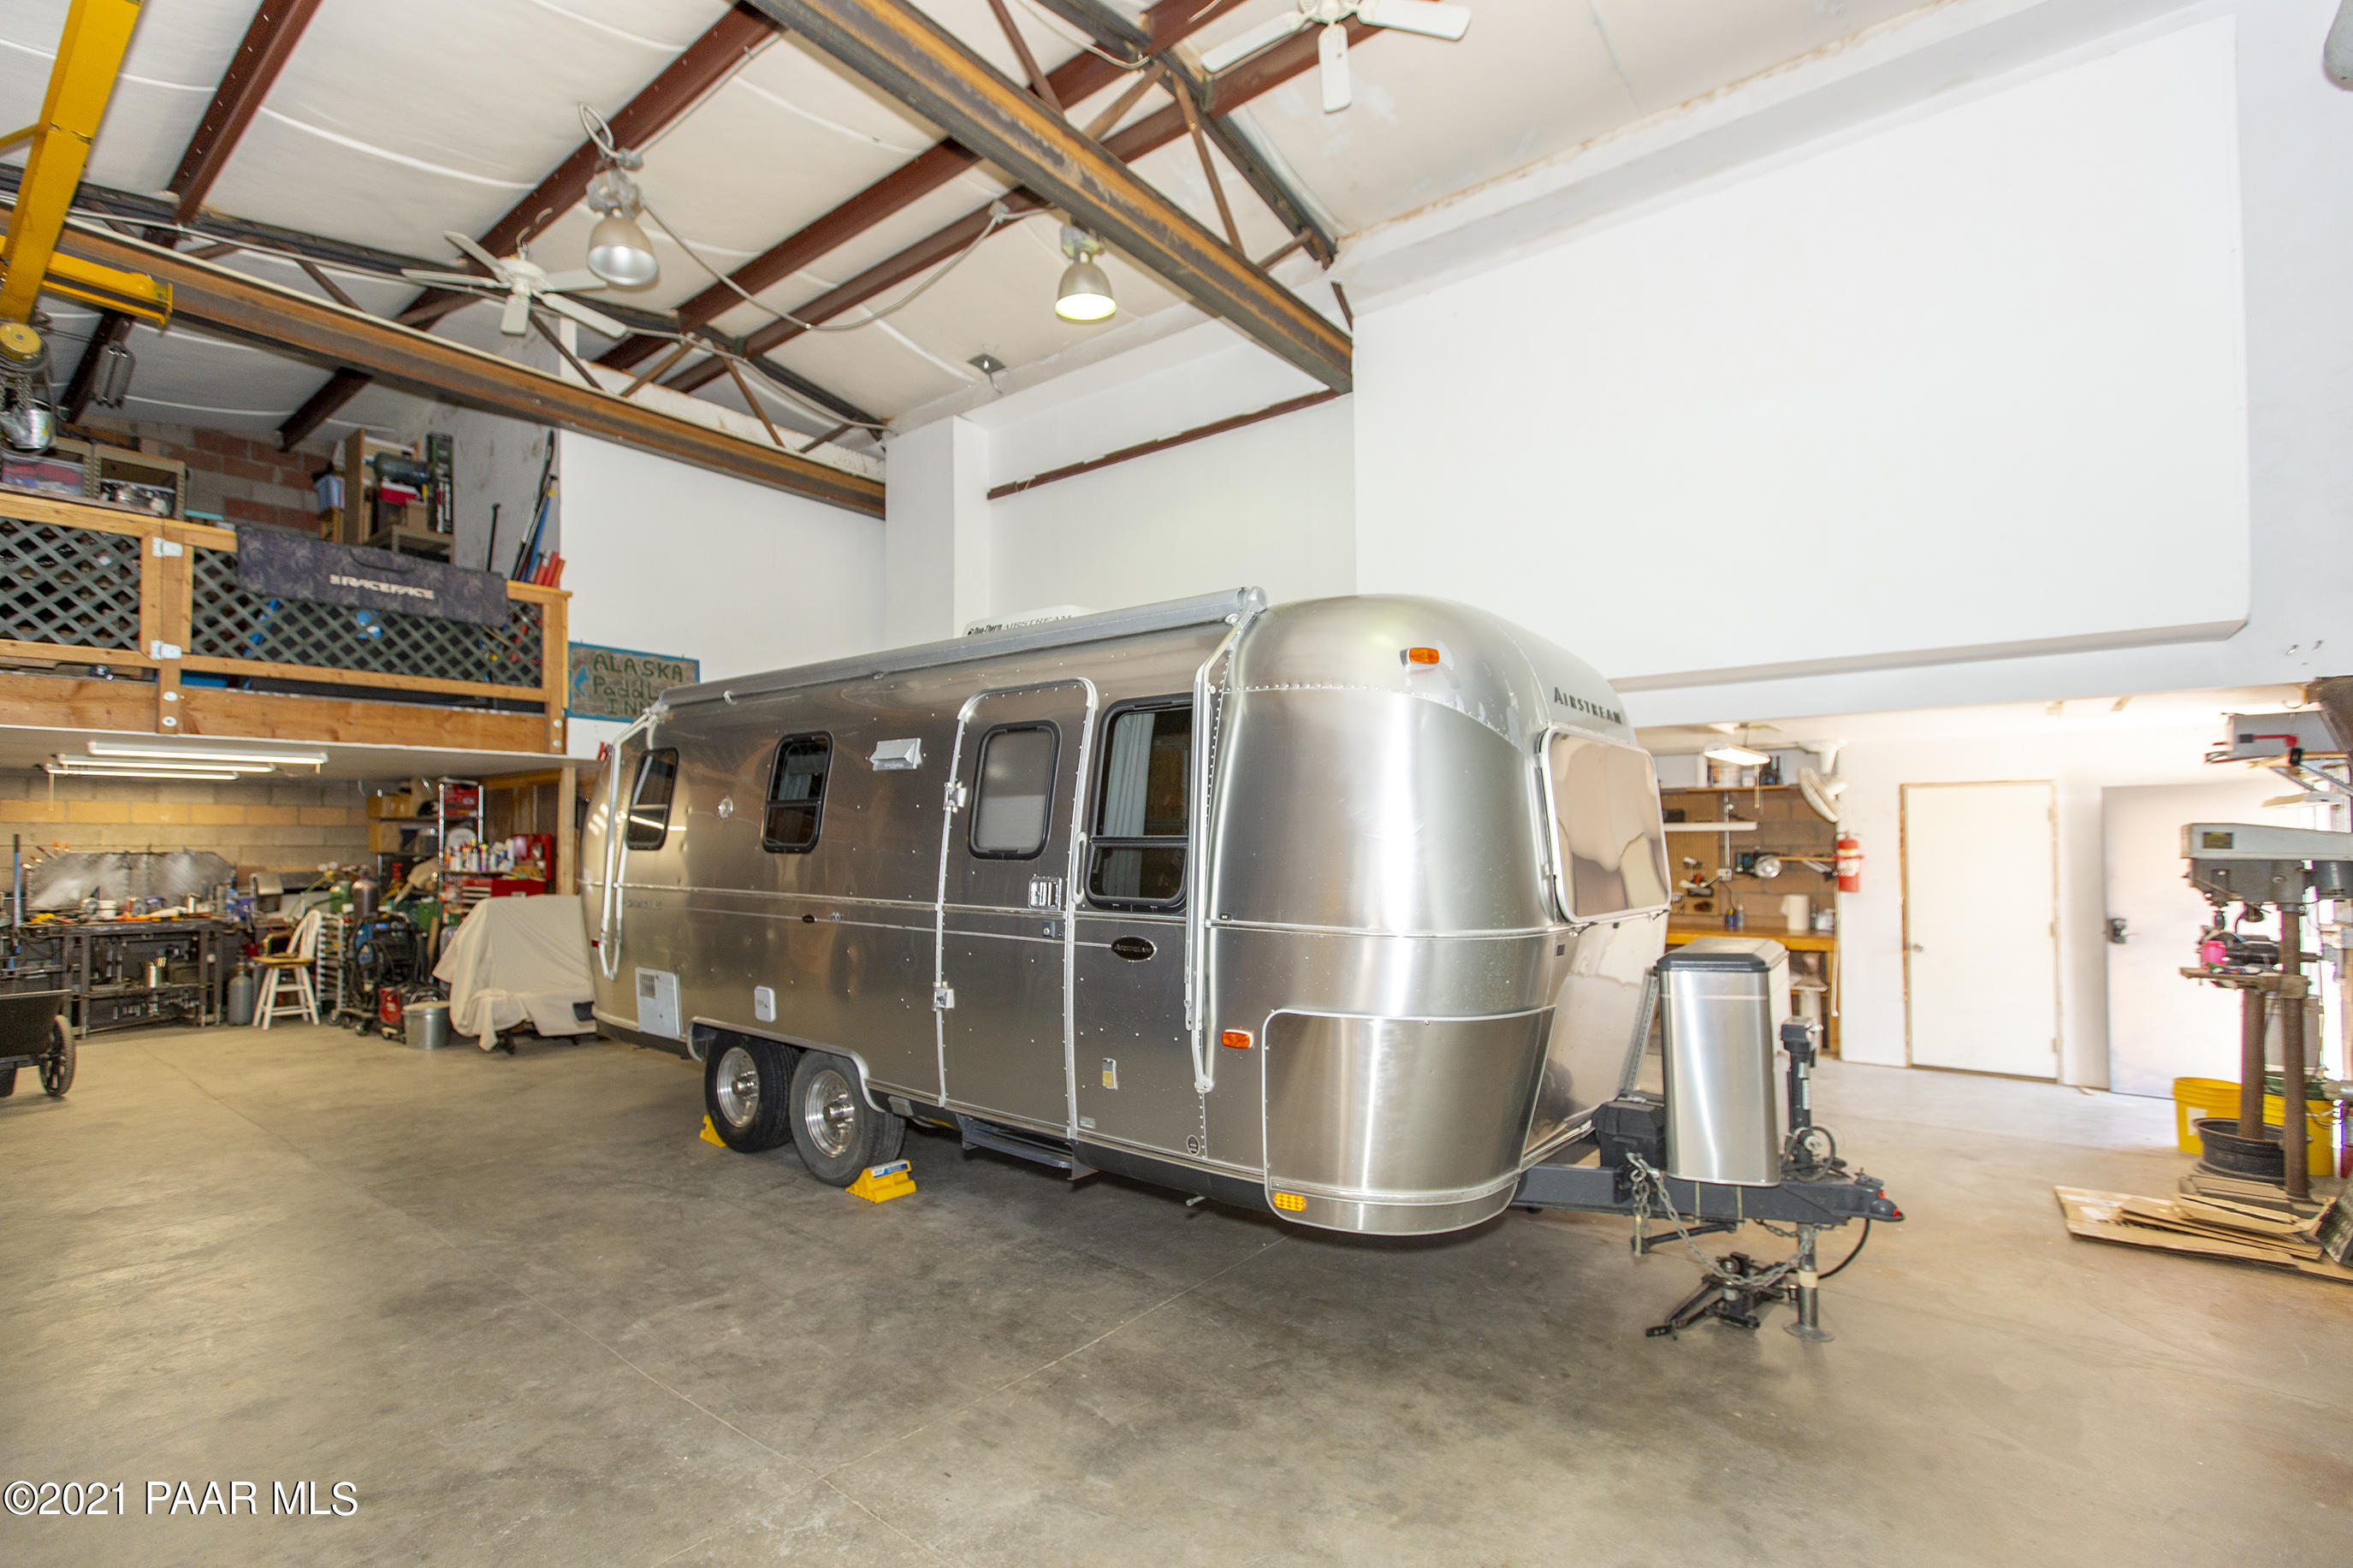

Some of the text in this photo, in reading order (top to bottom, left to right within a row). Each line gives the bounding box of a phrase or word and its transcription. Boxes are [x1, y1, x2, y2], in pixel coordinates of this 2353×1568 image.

[592, 654, 684, 683] ALASKA
[592, 675, 660, 701] PaddL
[1554, 687, 1622, 725] AIRSTREAM
